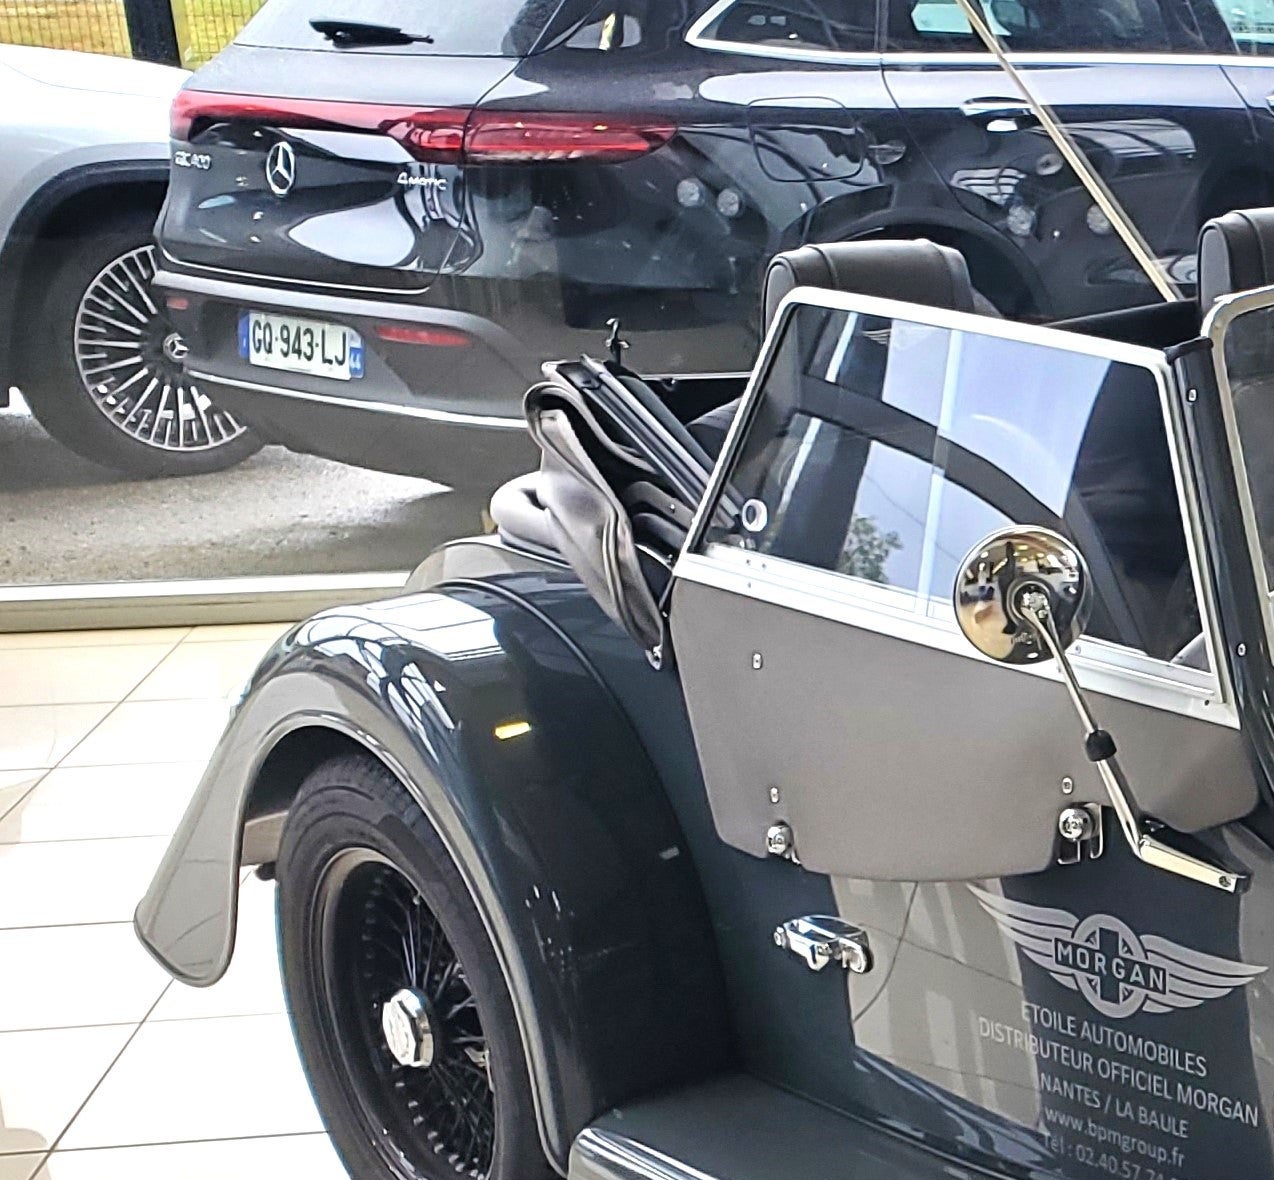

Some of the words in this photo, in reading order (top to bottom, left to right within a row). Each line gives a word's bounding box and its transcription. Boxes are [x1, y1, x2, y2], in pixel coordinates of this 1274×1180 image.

[252, 319, 347, 366] GQ-943-LJ
[1057, 941, 1164, 992] MORGAN
[1021, 1001, 1077, 1037] ETOILE
[1080, 1020, 1208, 1078] AUTOMOBILES
[978, 1016, 1094, 1075] DISTRIBUTEUR
[1097, 1058, 1173, 1101] OFFICIEL
[1176, 1082, 1259, 1128] MORGAN
[1040, 1072, 1101, 1109] NANTES
[1103, 1094, 1112, 1115] /
[1115, 1098, 1135, 1121] LA
[1138, 1106, 1190, 1139] BAULE
[1044, 1106, 1186, 1168] www.bpmgroup.fr
